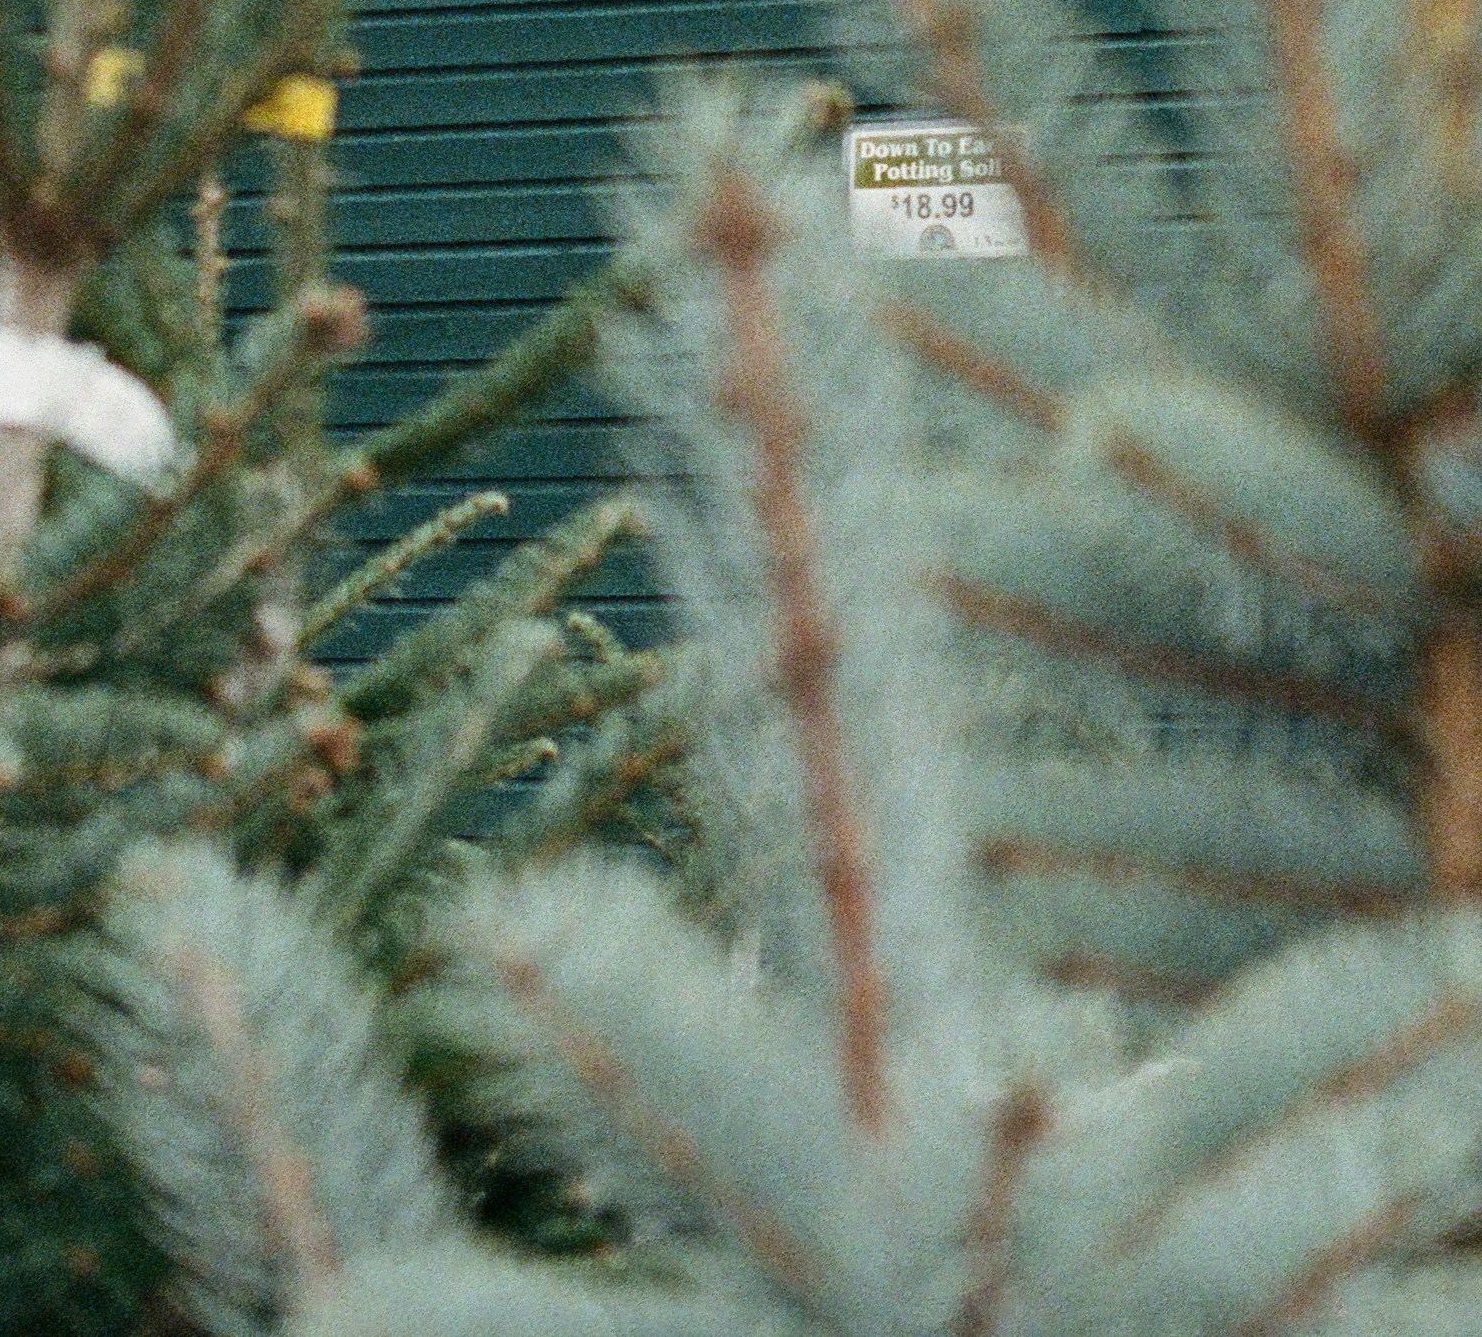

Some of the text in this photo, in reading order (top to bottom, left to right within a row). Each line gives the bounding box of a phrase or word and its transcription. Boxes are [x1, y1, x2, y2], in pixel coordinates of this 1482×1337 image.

[860, 140, 919, 159] Down
[926, 138, 954, 157] To
[873, 161, 953, 183] Potting
[891, 192, 975, 220] $18.99
